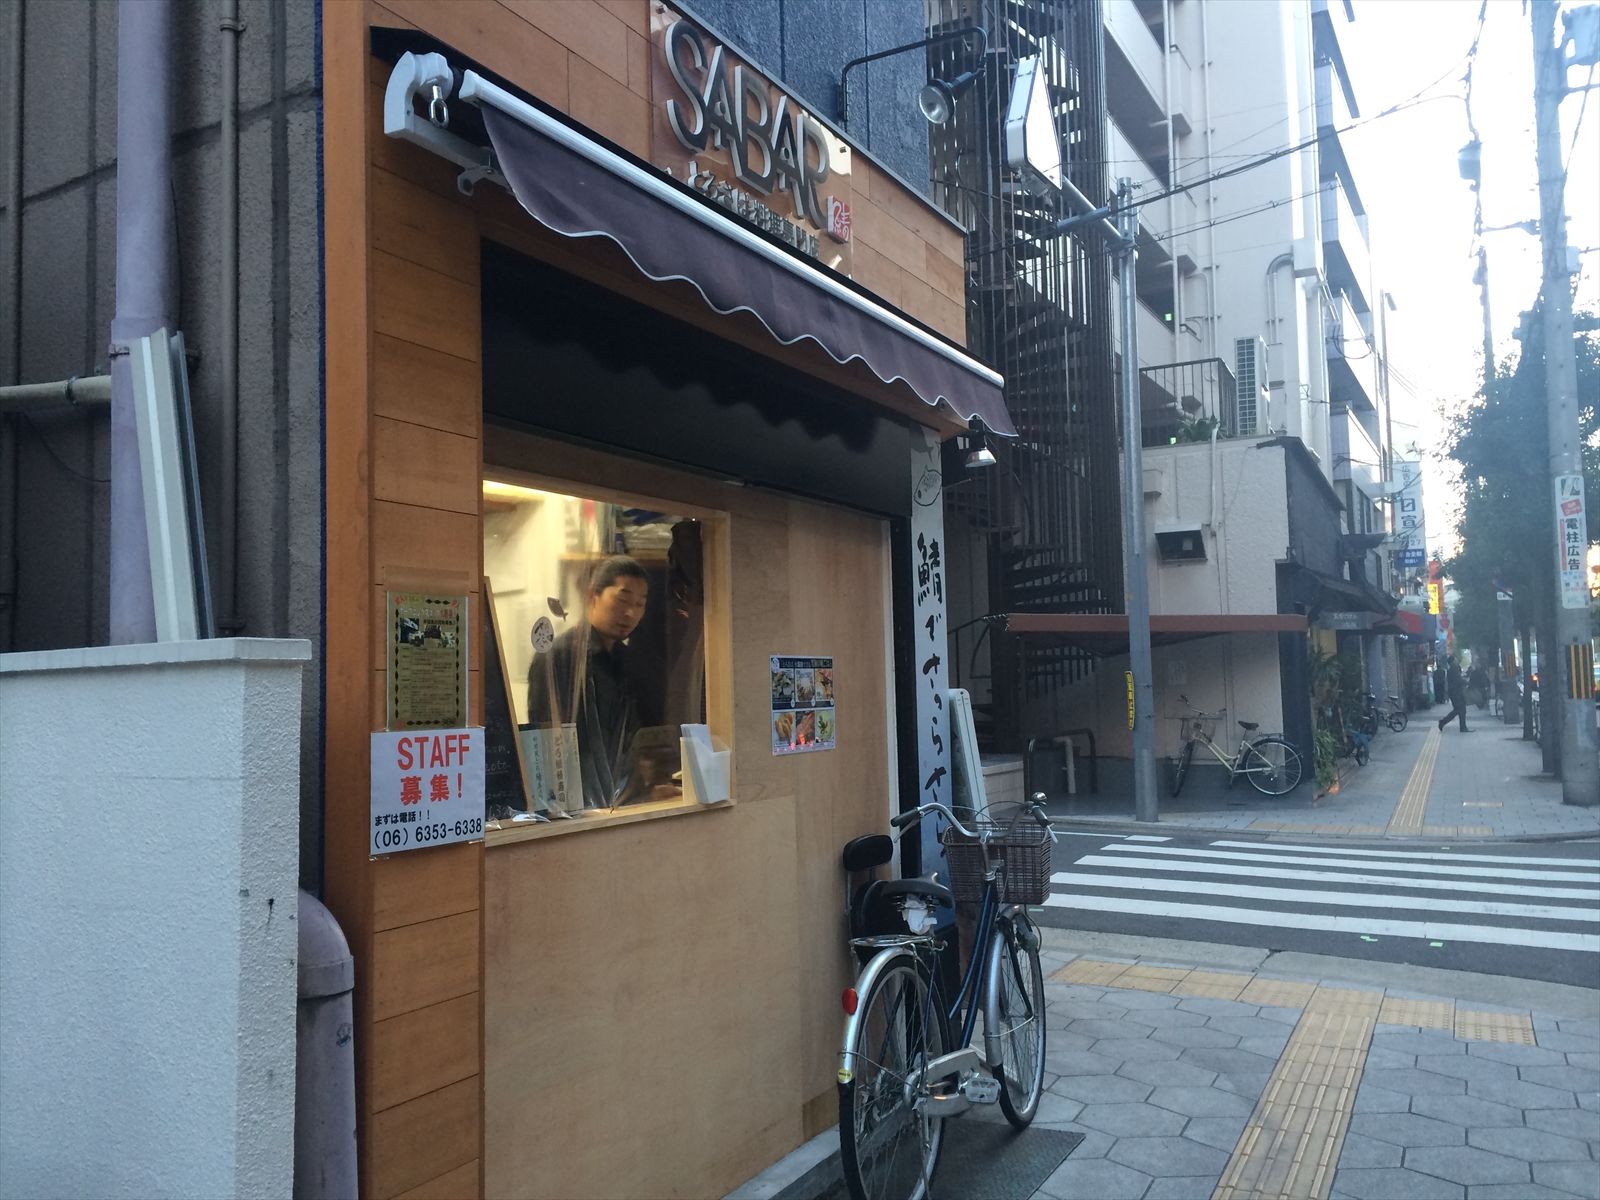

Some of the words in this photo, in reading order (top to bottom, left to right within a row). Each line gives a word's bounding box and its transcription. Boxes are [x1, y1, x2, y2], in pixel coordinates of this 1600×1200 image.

[664, 19, 829, 230] SABAR
[1565, 518, 1580, 570] 電柱広告
[397, 734, 470, 770] STAFF
[415, 816, 483, 842] 6353-6338
